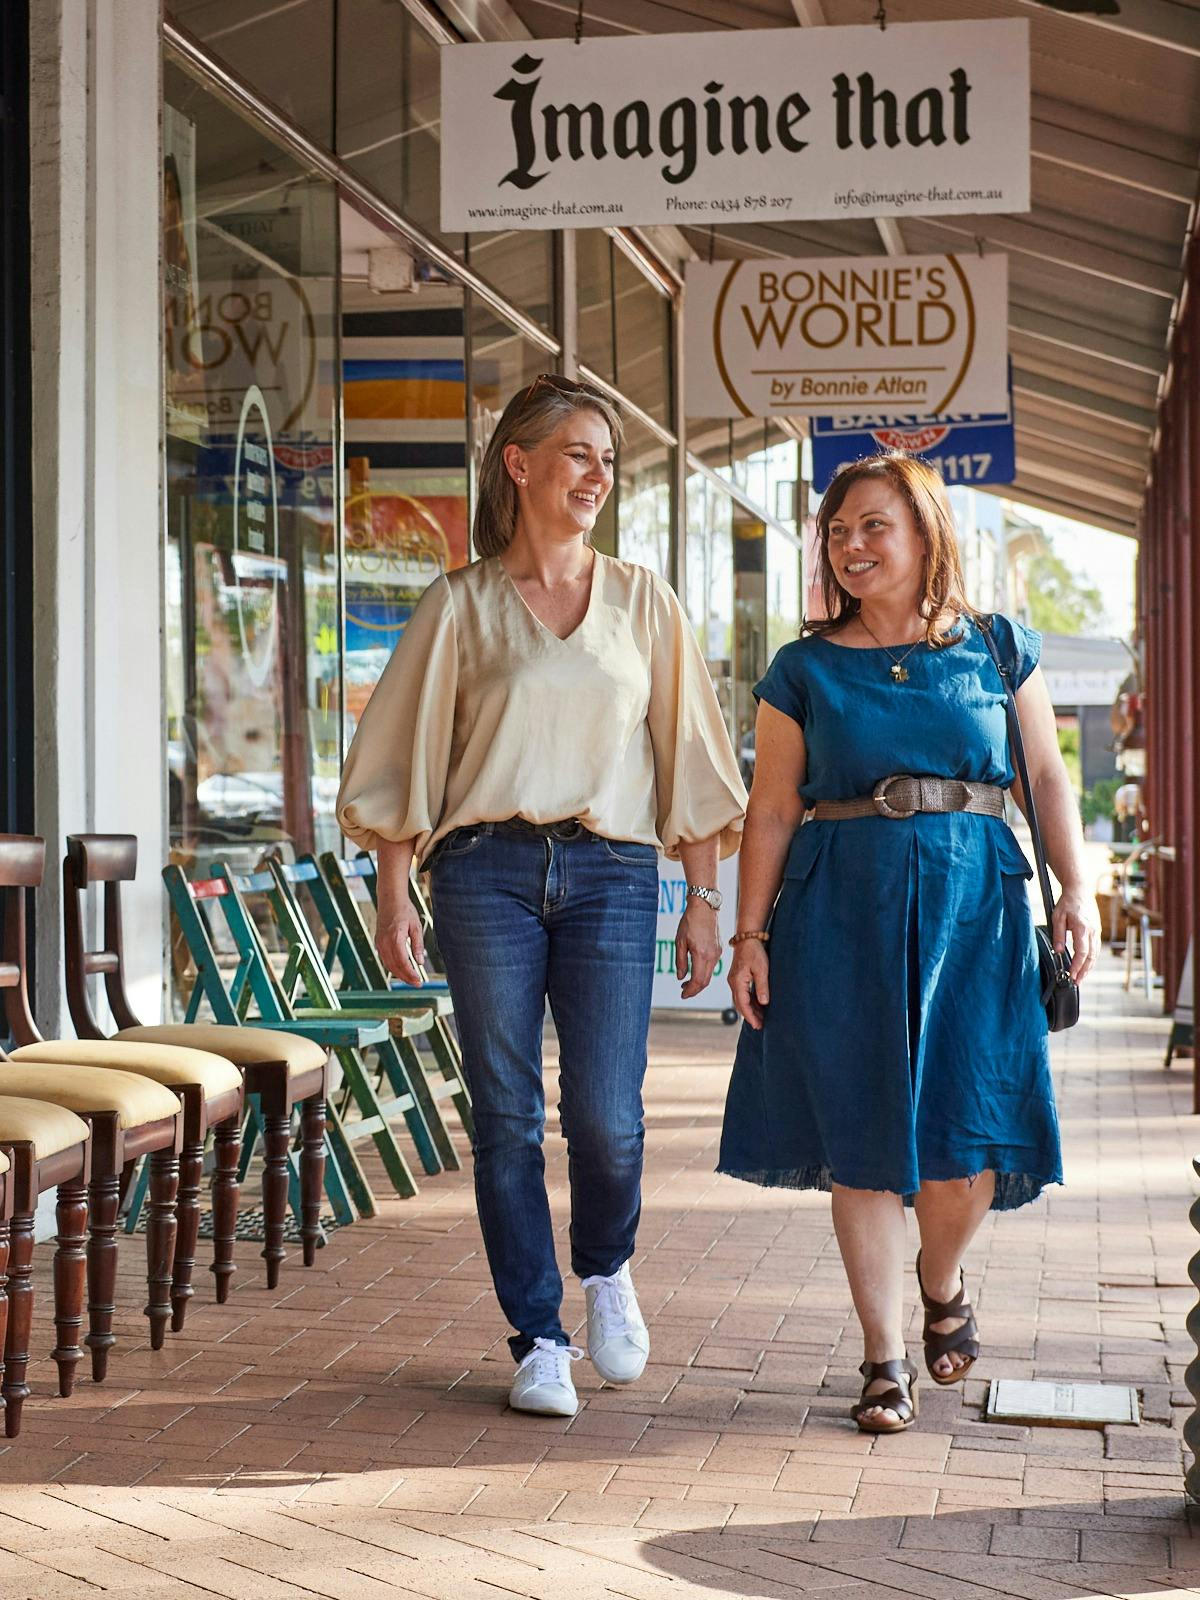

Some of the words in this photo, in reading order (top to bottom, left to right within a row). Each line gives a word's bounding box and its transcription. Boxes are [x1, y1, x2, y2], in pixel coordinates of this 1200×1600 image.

[832, 67, 972, 149] that
[666, 196, 707, 211] Phone:
[710, 198, 740, 212] 0434
[744, 195, 767, 210] 878
[770, 197, 793, 210] 207
[834, 186, 1003, 209] info@imagine-that.com.au
[468, 200, 624, 220] www.imagine-that.com.au
[759, 266, 947, 304] BONNIE'S
[741, 301, 957, 351] WORLD
[771, 378, 795, 400] by
[801, 376, 868, 396] Bonnie
